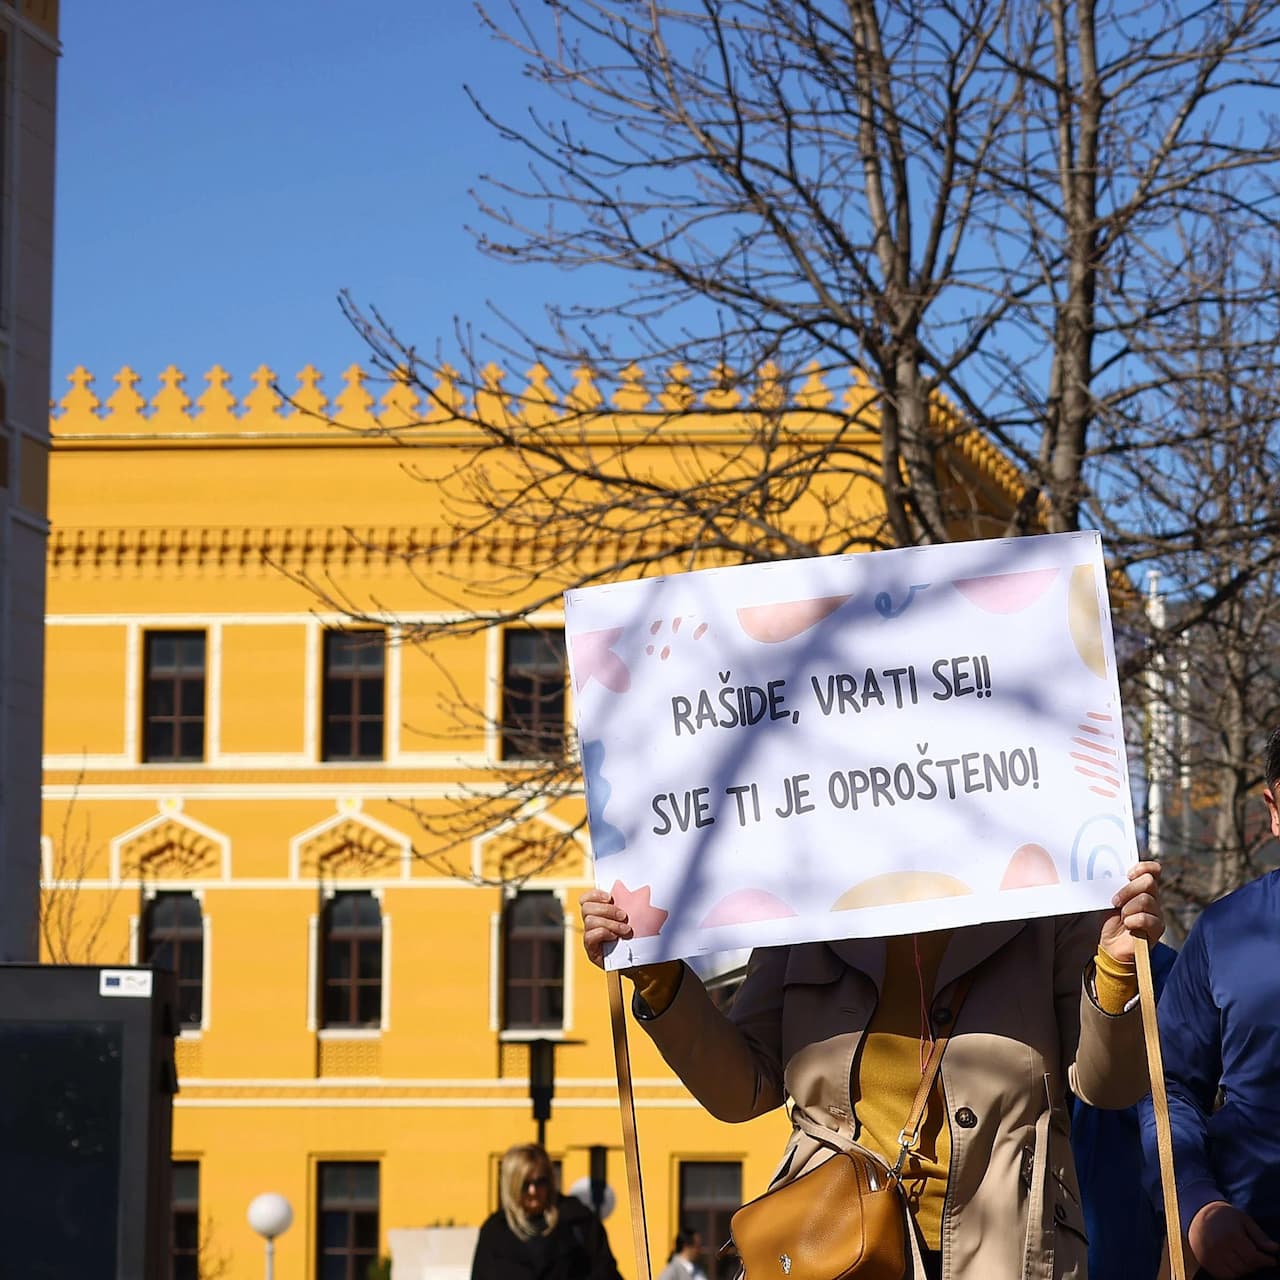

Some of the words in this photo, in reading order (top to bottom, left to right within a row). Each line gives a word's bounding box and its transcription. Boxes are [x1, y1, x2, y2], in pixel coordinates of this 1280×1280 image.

[671, 670, 801, 737] RAŠIDE,
[811, 664, 919, 716] VRATI
[932, 654, 993, 701] SE!!
[651, 786, 716, 836] SVE
[725, 782, 761, 827] TI
[776, 774, 815, 818] JE
[829, 743, 1039, 810] OPROŠTENO!
